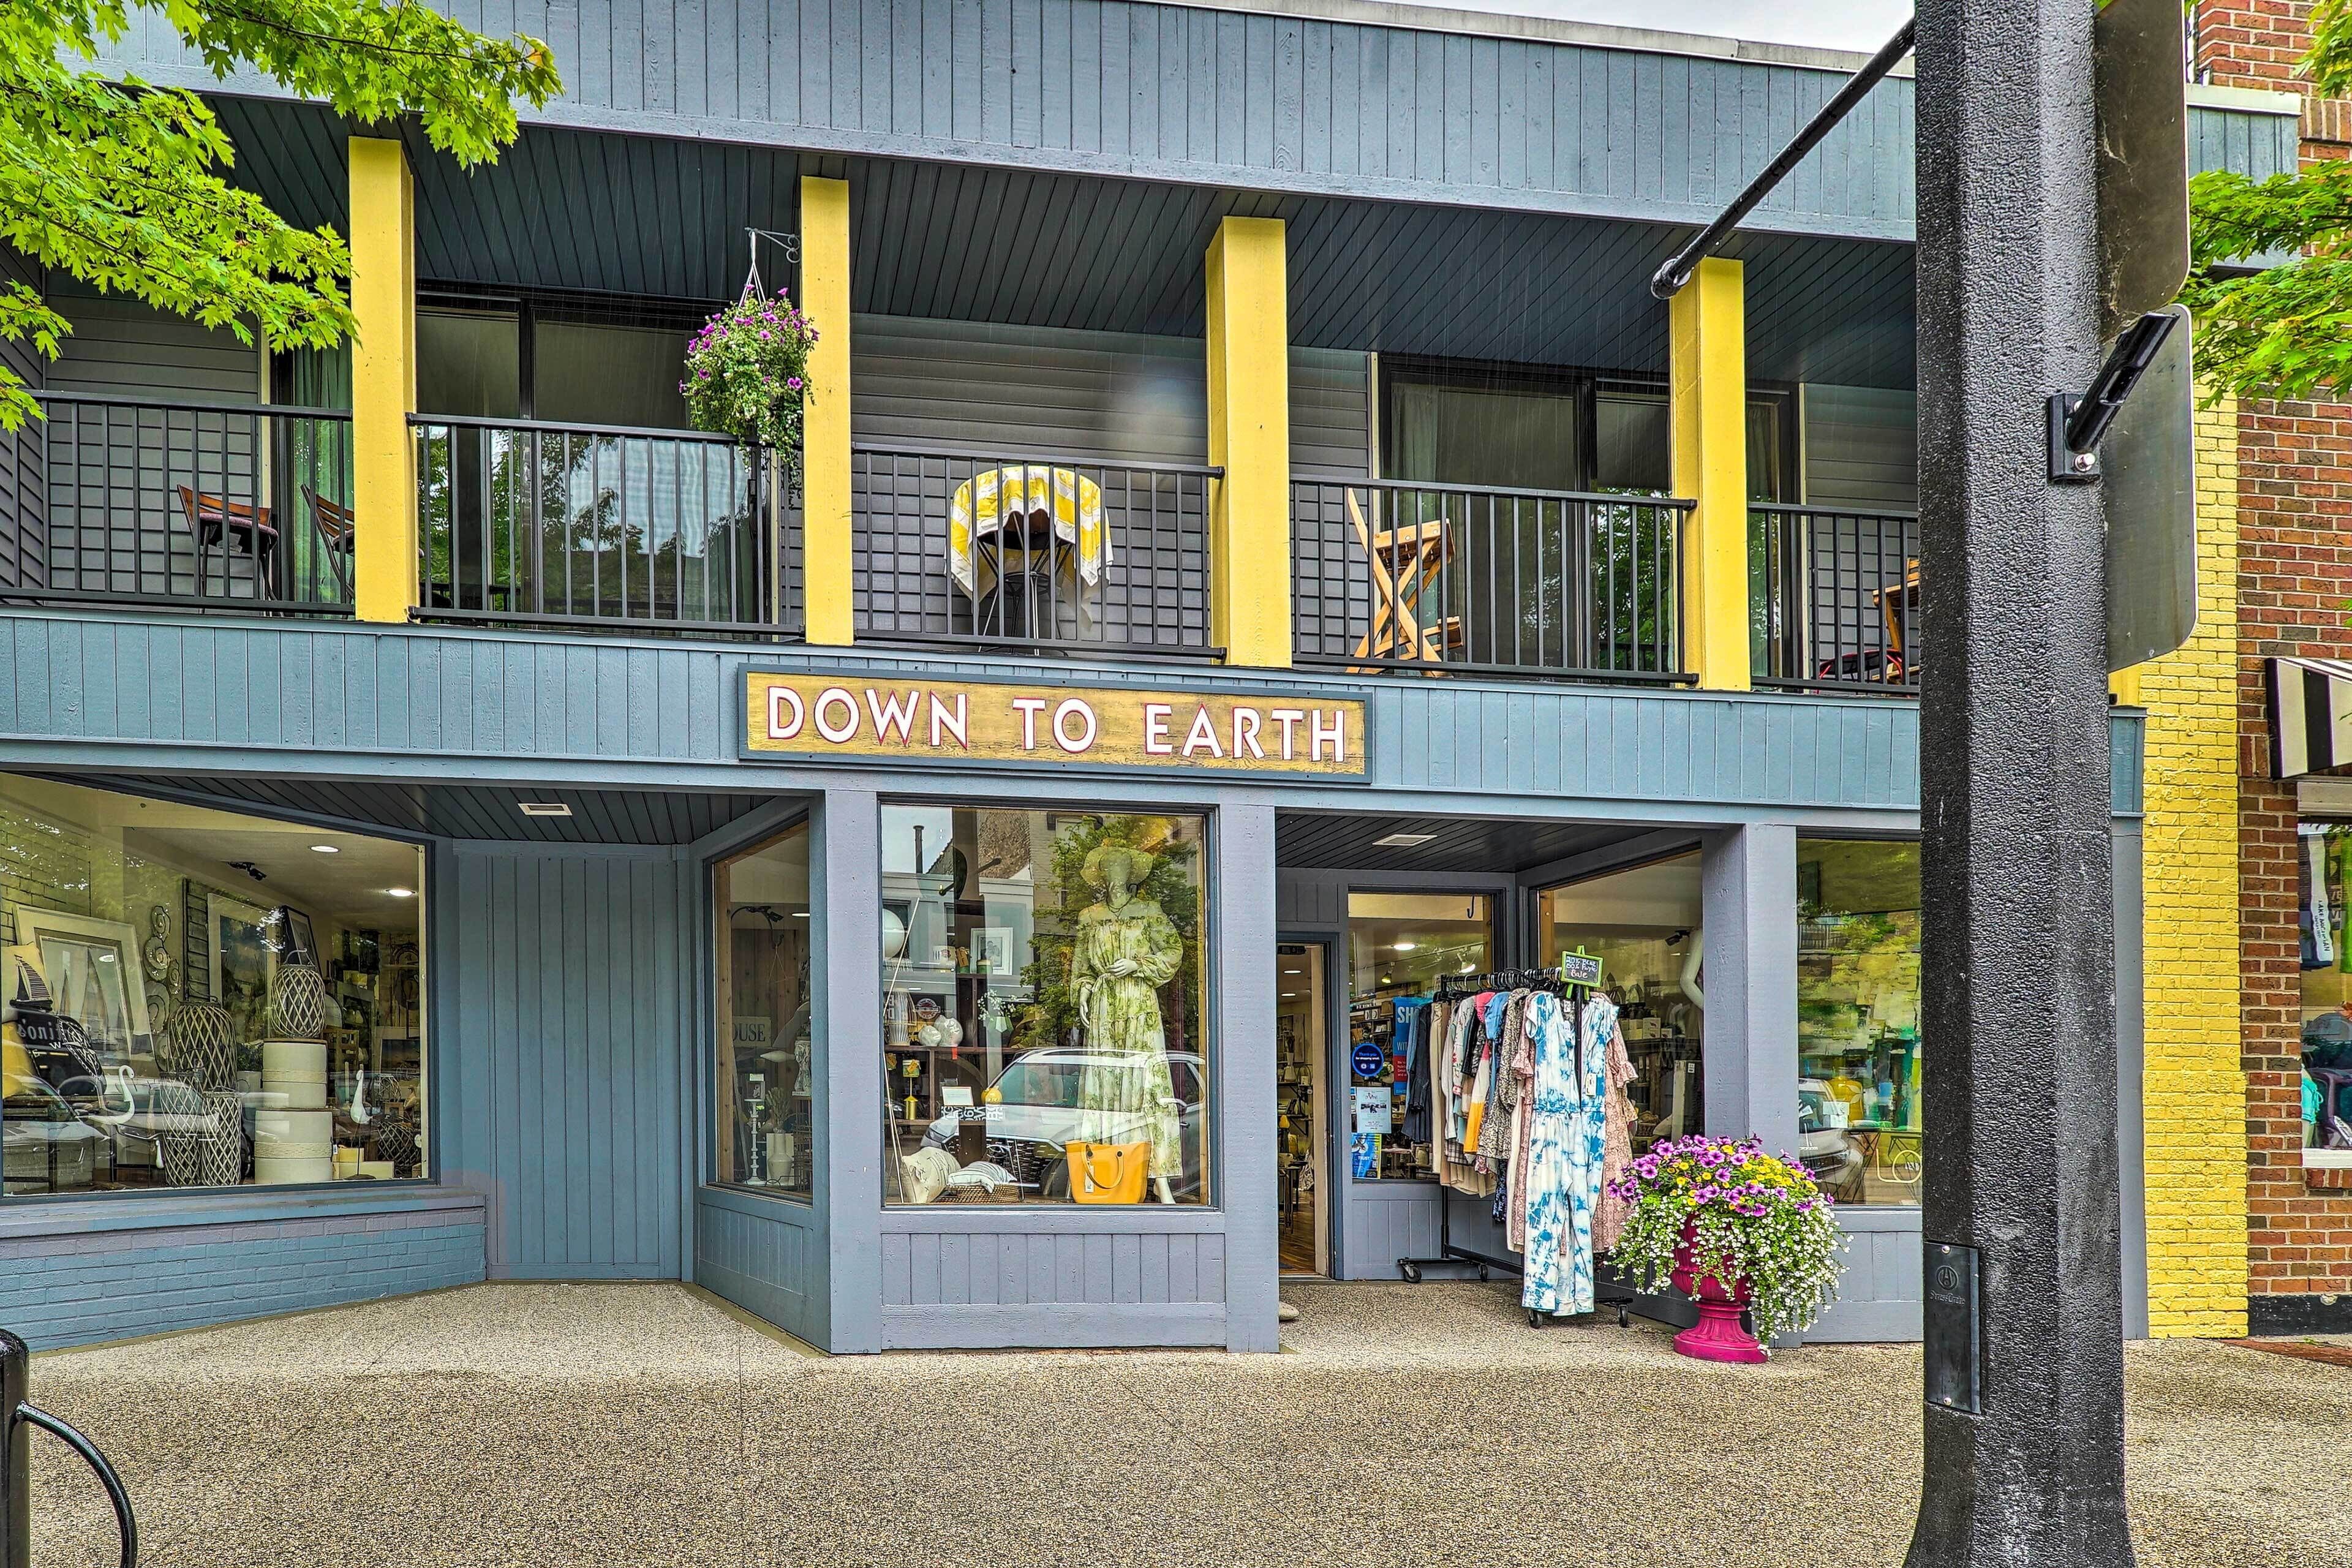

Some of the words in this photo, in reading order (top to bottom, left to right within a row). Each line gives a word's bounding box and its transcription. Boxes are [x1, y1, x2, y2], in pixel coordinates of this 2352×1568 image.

[767, 685, 969, 750] DOWN
[1012, 696, 1098, 754] TO
[1144, 703, 1344, 763] EARTH
